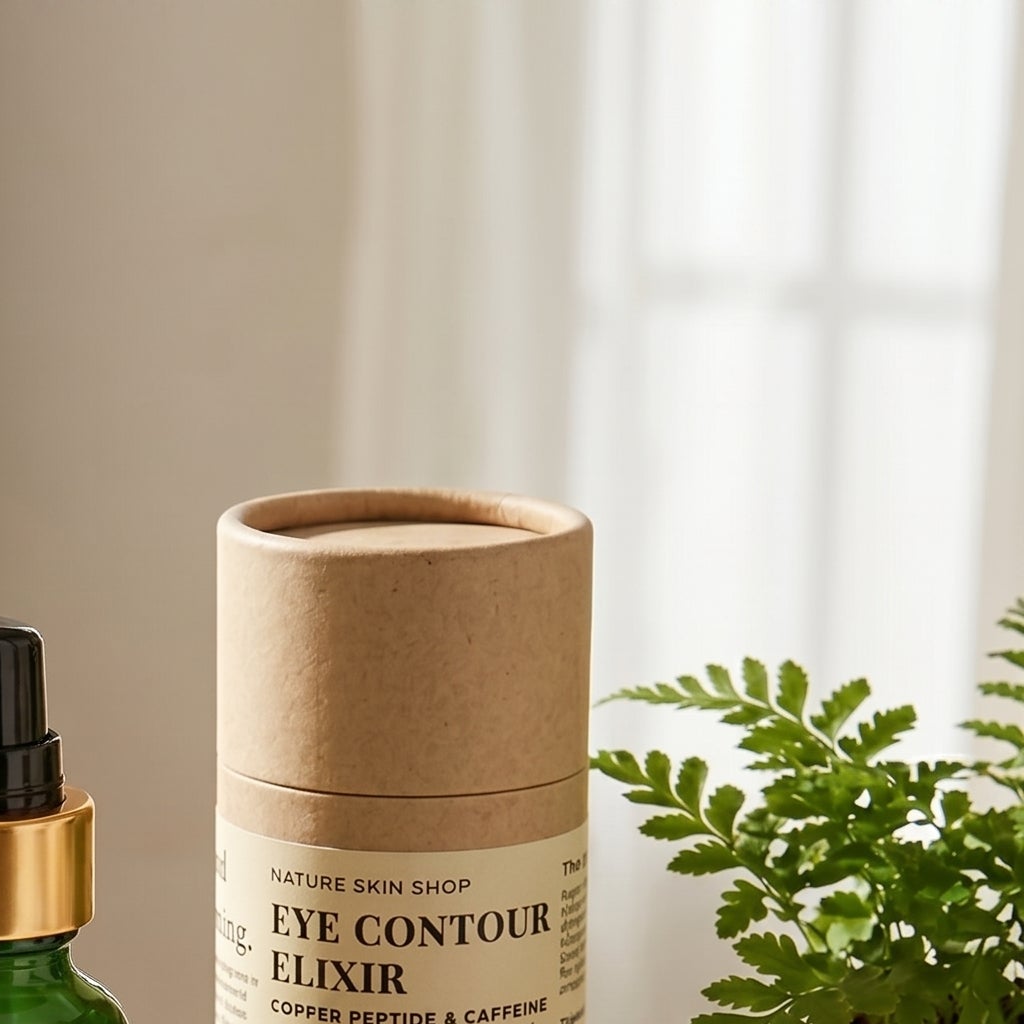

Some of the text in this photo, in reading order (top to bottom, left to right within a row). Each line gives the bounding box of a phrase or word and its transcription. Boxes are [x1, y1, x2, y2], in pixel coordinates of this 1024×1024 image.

[272, 868, 470, 895] NATURE SKIN SHOP
[271, 903, 339, 944] EYE
[355, 903, 550, 947] CONTOUR
[272, 951, 407, 994] ELIXIR
[445, 1012, 456, 1024] &
[464, 997, 547, 1024] CAFFEINE
